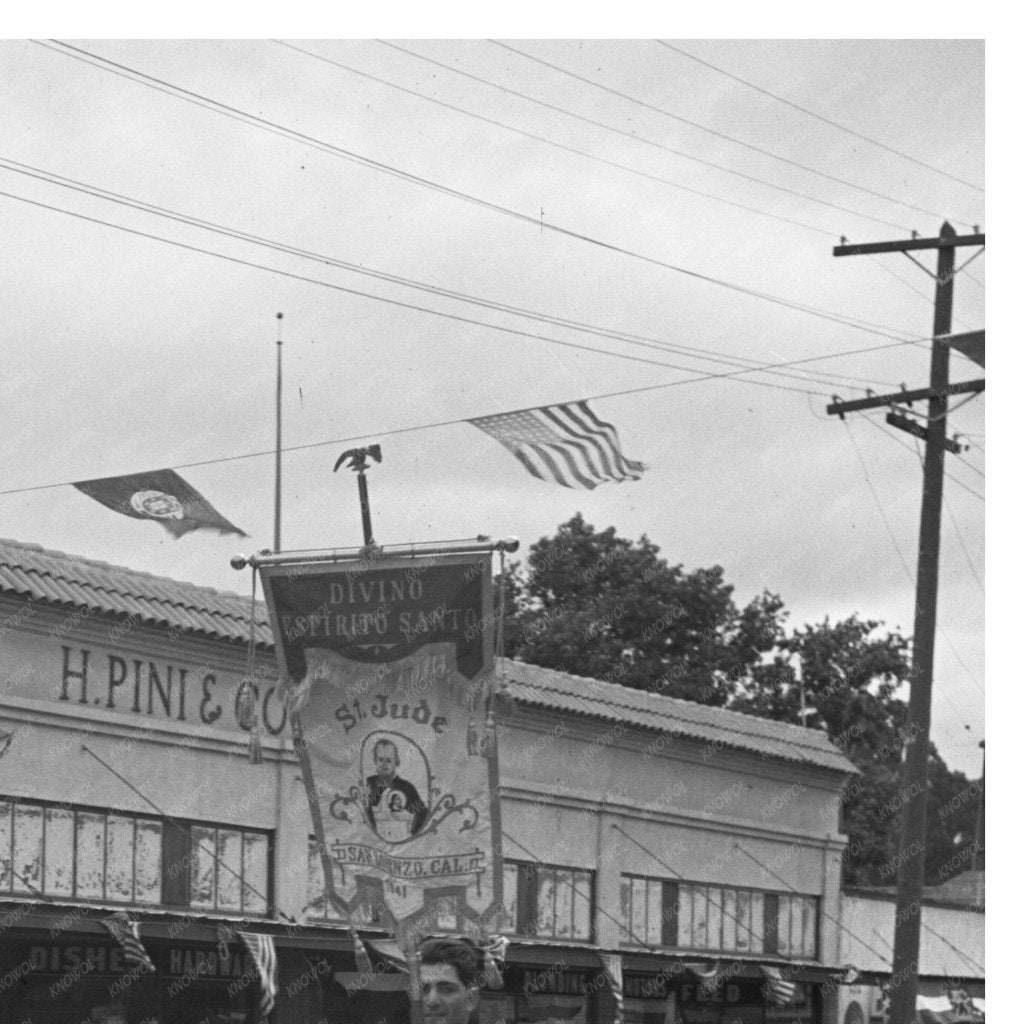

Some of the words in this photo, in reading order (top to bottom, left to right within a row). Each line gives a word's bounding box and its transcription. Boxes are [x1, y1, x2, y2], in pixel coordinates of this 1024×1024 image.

[330, 579, 423, 604] DIVINO
[400, 608, 477, 633] SANTO
[371, 694, 448, 734] Jude
[30, 945, 125, 973] DISHE
